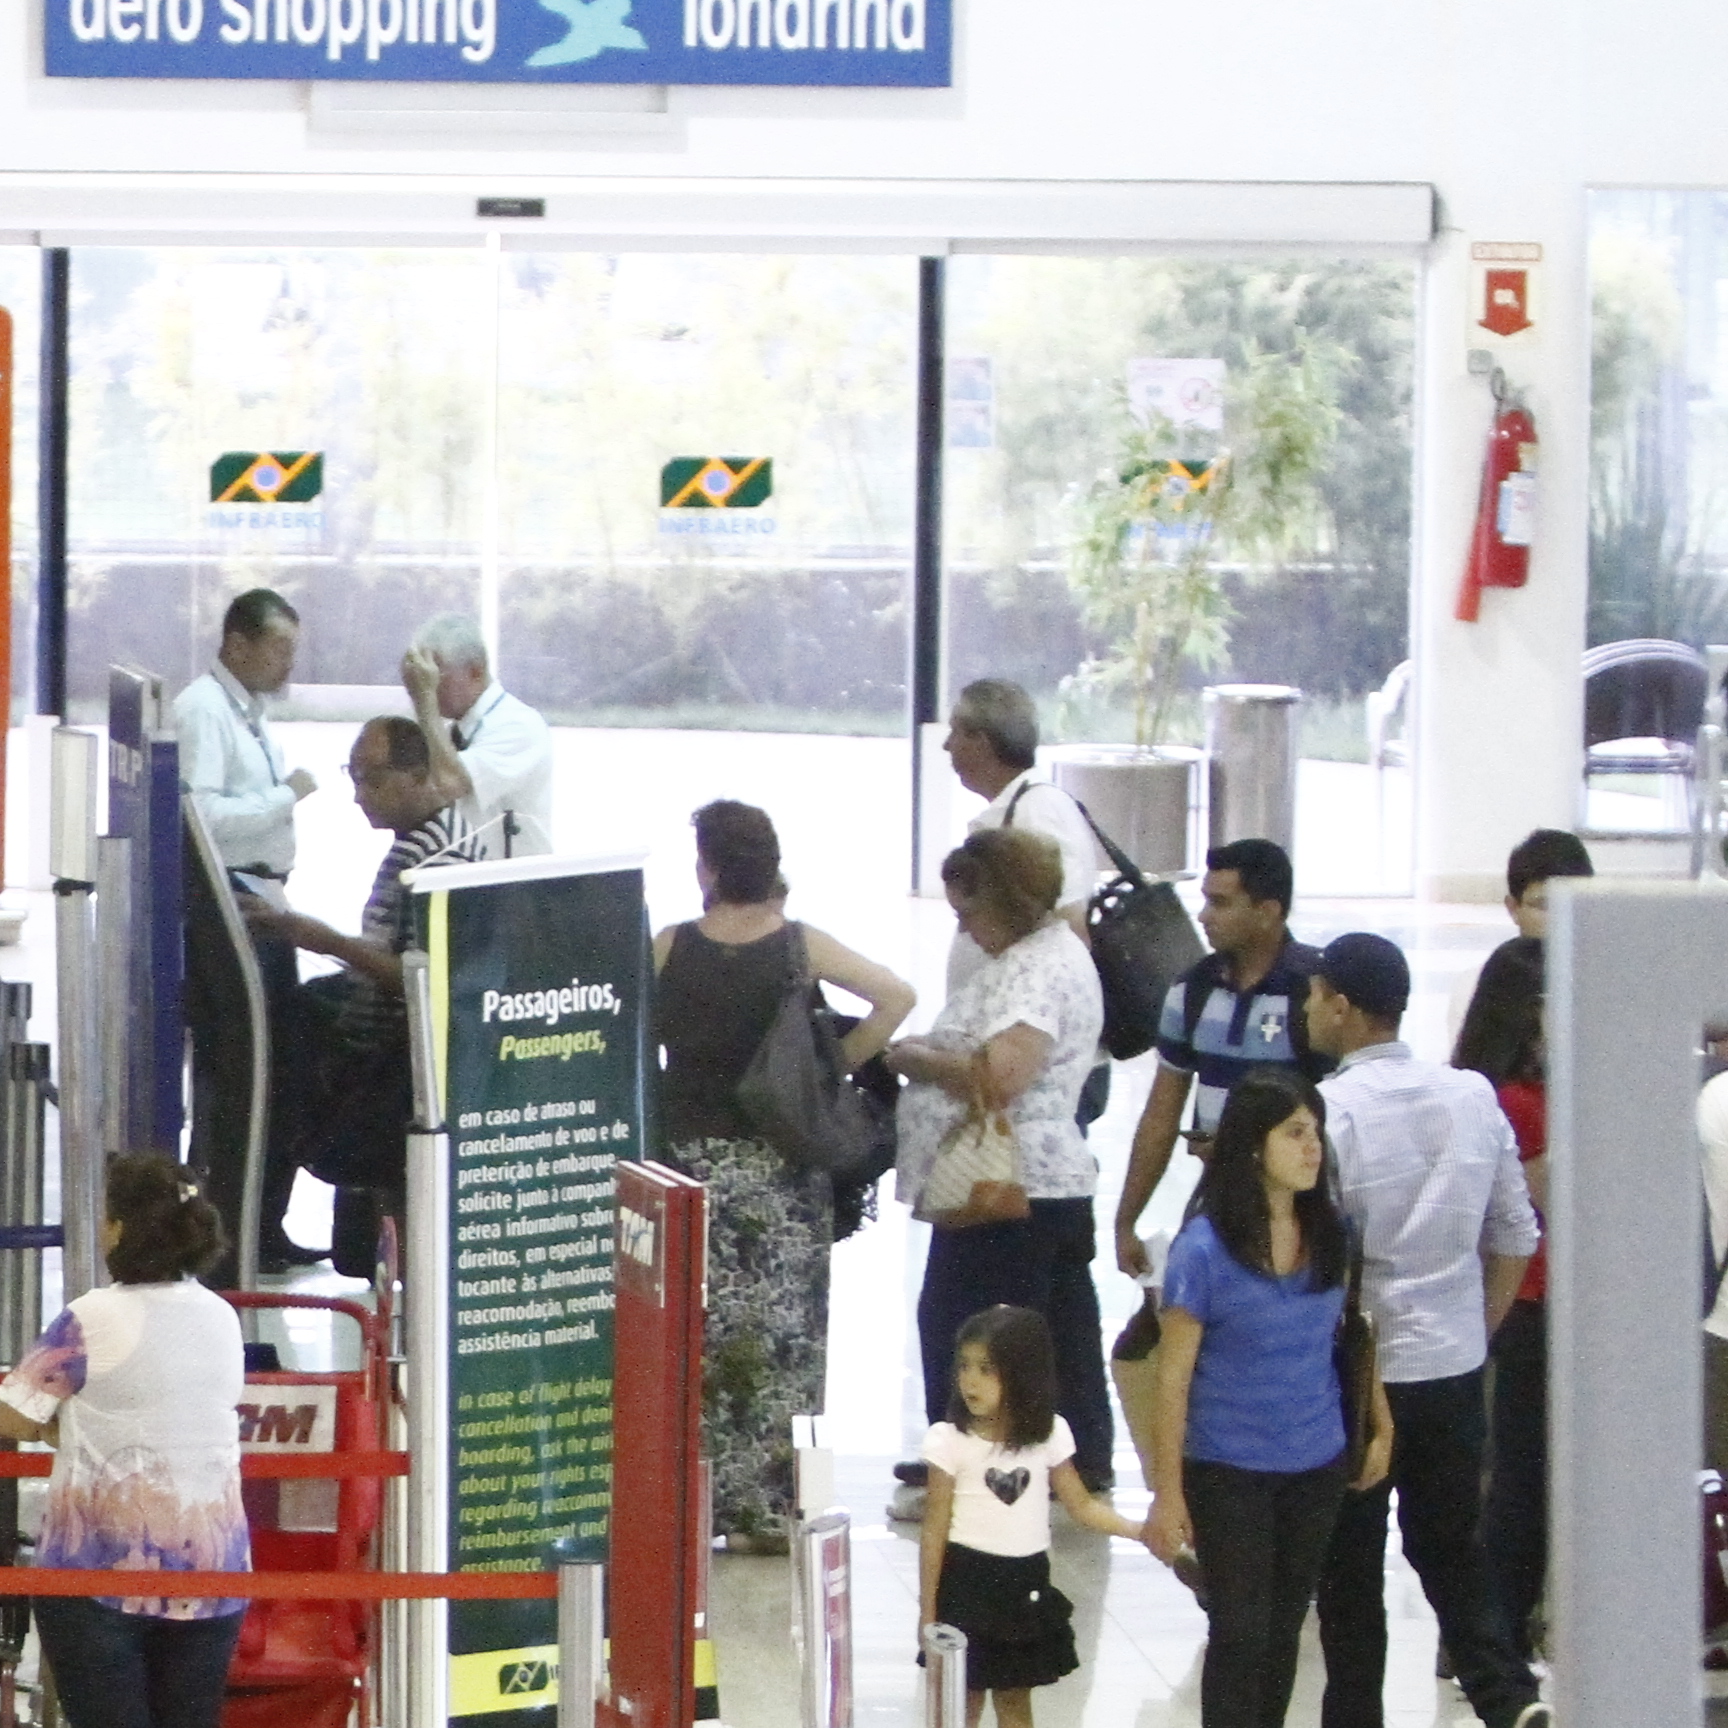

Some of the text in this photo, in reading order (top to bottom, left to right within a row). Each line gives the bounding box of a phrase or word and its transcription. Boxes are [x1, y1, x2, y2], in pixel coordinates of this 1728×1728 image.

[658, 516, 776, 534] INFRAERO
[482, 977, 621, 1025] Passageiros,
[499, 1029, 606, 1062] Passengers,
[458, 1099, 596, 1129] em caso de atraso ou
[458, 1119, 629, 1157] cancelamento de voo e de
[458, 1161, 534, 1189] preterição
[535, 1156, 550, 1178] de
[457, 1191, 513, 1213] solicite
[516, 1187, 549, 1213] junto
[457, 1221, 501, 1241] aérea
[506, 1212, 578, 1236] informativo
[458, 1247, 521, 1269] direitos,
[525, 1246, 546, 1263] em
[549, 1234, 597, 1262] especial
[458, 1276, 517, 1297] tocante
[521, 1273, 537, 1292] às
[458, 1298, 564, 1326] reacomodação,
[458, 1319, 599, 1354] assistência material.
[458, 1392, 473, 1410] in
[477, 1391, 514, 1407] case
[458, 1413, 552, 1438] cancellation
[556, 1407, 579, 1428] and
[458, 1443, 535, 1467] boarding,
[459, 1474, 507, 1494] about
[459, 1498, 538, 1526] regarding
